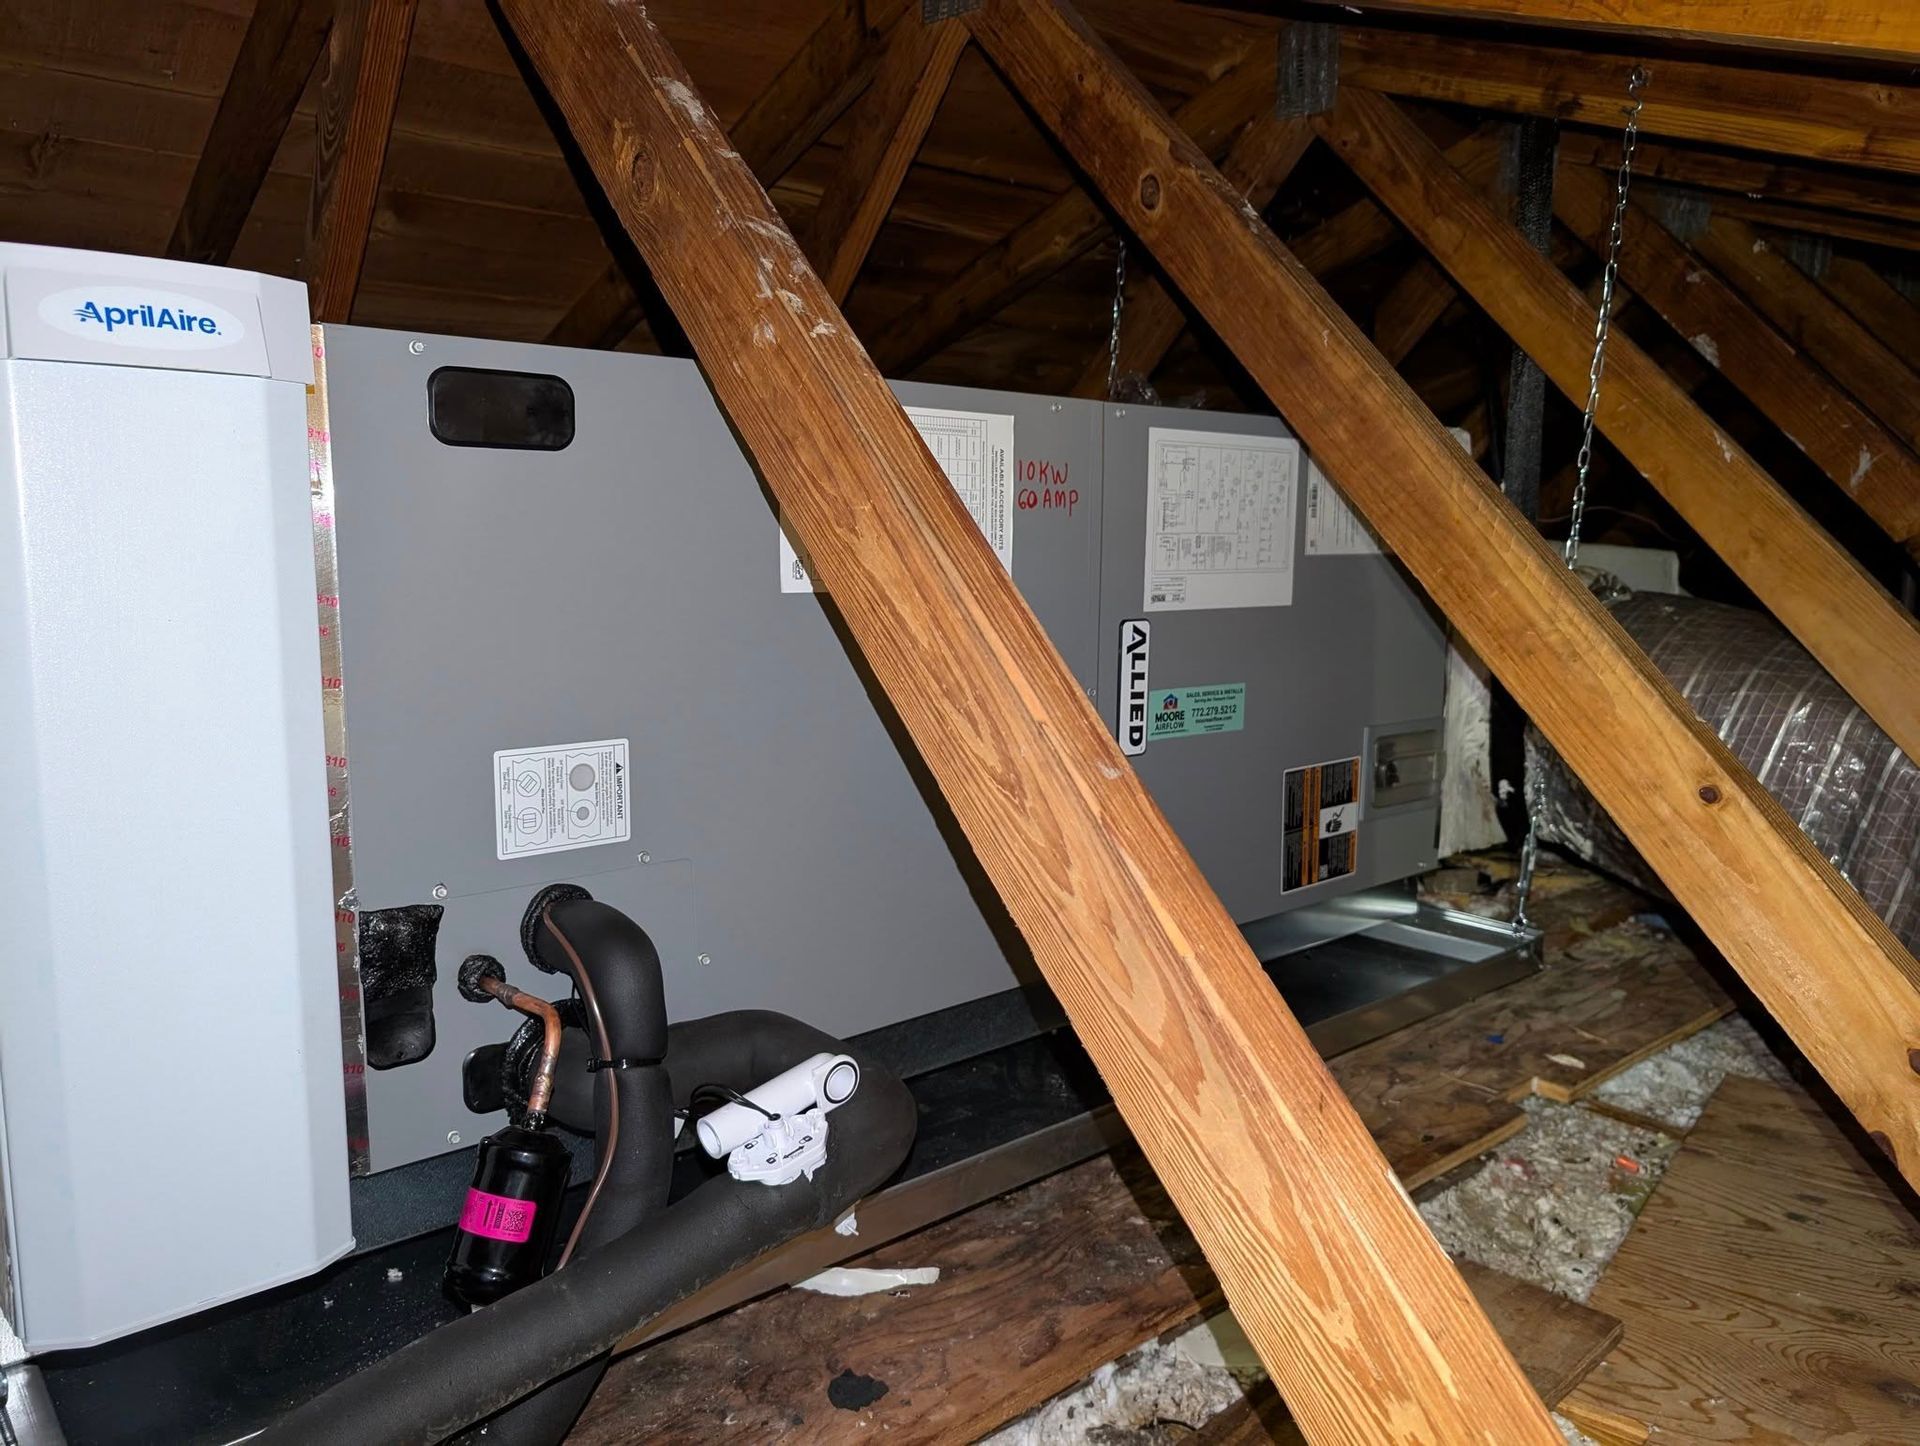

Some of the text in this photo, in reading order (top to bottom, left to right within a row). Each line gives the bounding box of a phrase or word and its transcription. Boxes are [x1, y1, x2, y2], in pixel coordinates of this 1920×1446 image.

[73, 301, 219, 335] AprilAire
[1018, 489, 1038, 510] 60
[1127, 624, 1147, 747] ALLIED
[1155, 710, 1185, 723] MOORE
[1191, 704, 1237, 717] 772.279.5212
[1154, 721, 1184, 732] AIRFLOW
